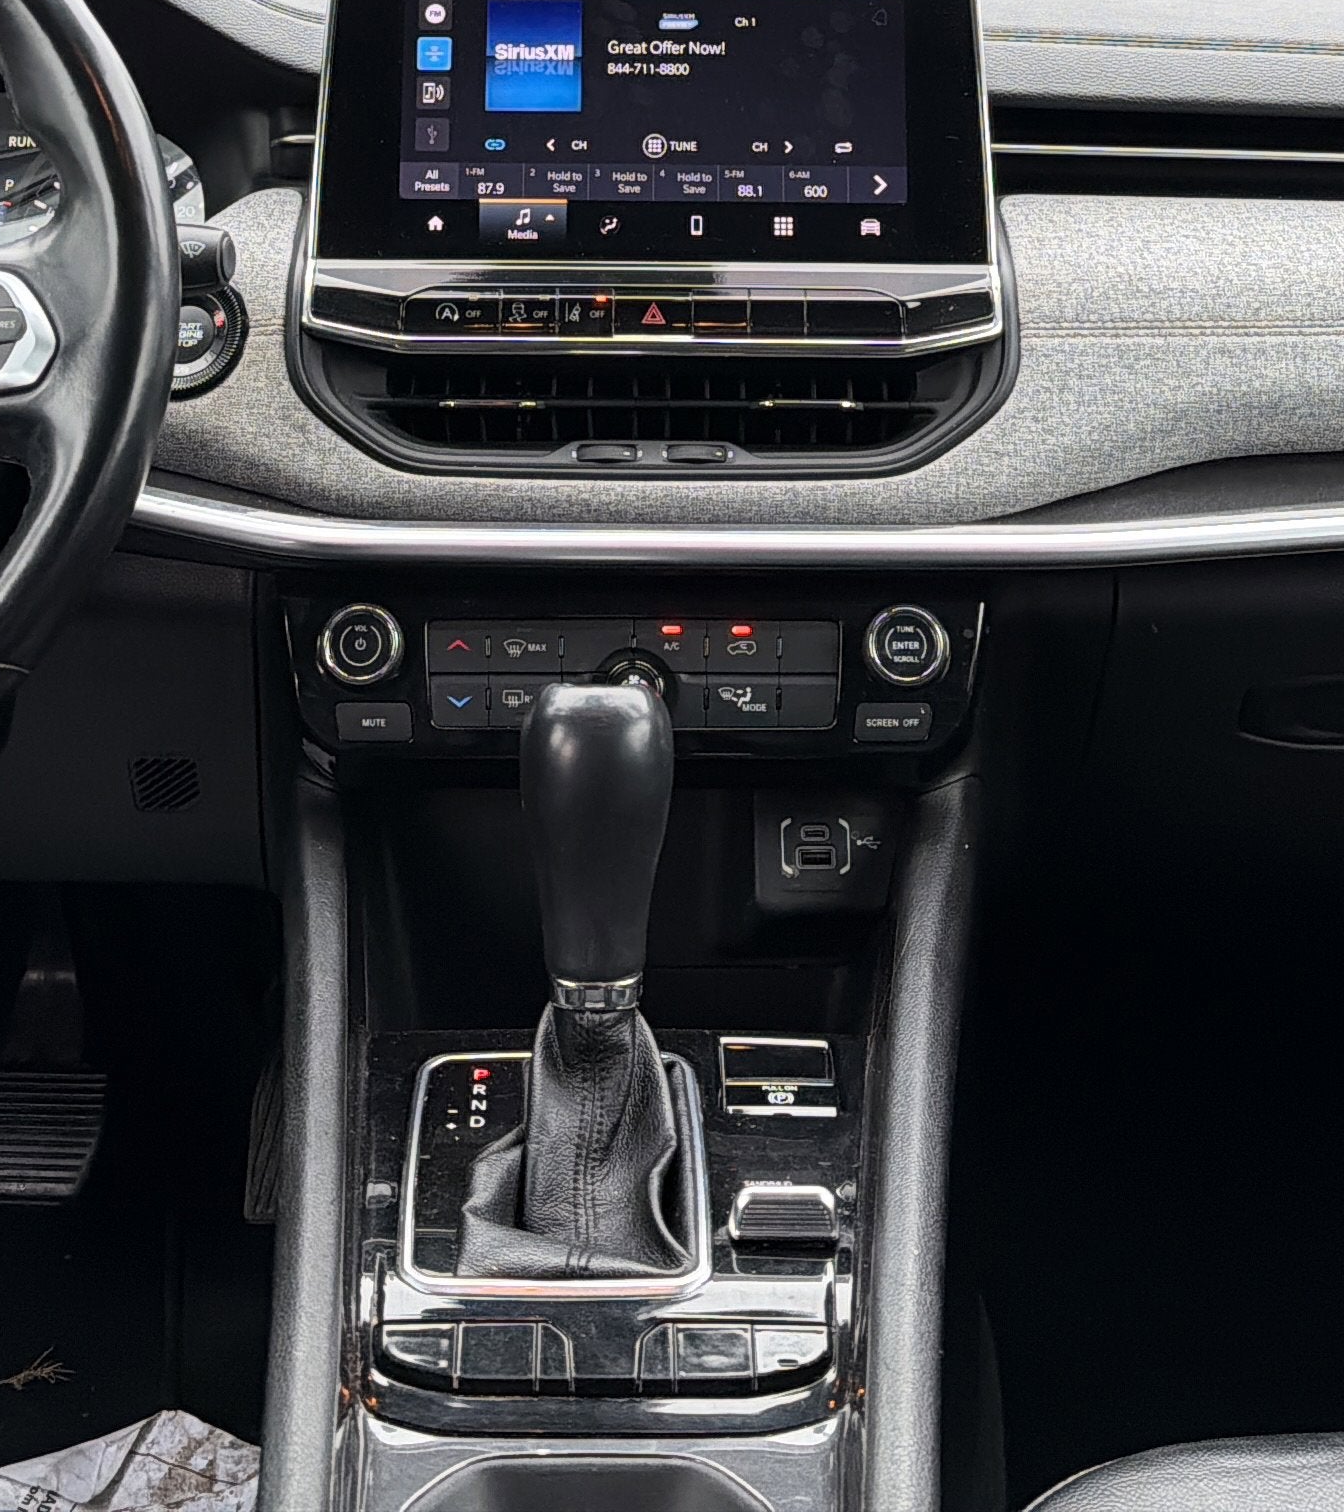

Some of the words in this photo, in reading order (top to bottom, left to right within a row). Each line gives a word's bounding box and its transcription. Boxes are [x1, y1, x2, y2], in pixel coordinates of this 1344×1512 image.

[428, 10, 443, 19] FM
[734, 17, 749, 28] Ch
[751, 17, 757, 27] 1
[494, 43, 575, 63] SiriusXM
[607, 41, 647, 55] Great
[649, 41, 686, 55] Offer
[688, 41, 726, 55] Now!
[607, 62, 690, 76] 844-711-8800
[571, 140, 588, 151] CH
[669, 140, 698, 152] TUNE
[752, 142, 768, 153] CH
[425, 169, 439, 180] All
[465, 167, 485, 177] 1-FM
[529, 168, 536, 177] 2
[547, 171, 570, 182] Hold
[571, 171, 583, 182] to
[594, 169, 601, 178] 3
[612, 172, 635, 182] Hold
[636, 172, 648, 182] to
[659, 169, 666, 178] 4
[677, 172, 700, 183] Hold
[701, 172, 713, 183] to
[724, 169, 745, 179] 5-FM
[788, 170, 811, 180] 6-AM
[4, 178, 14, 191] P
[414, 181, 451, 193] Presets
[477, 182, 505, 195] 87.9
[553, 182, 577, 194] Save
[617, 183, 641, 195] Save
[682, 184, 706, 195] Save
[737, 185, 763, 198] 88.1
[804, 185, 828, 198] 600
[178, 206, 197, 218] 20
[507, 228, 539, 240] Media
[464, 309, 482, 319] OFF
[532, 309, 549, 320] OFF
[589, 309, 606, 320] OFF
[177, 339, 198, 348] TOP
[354, 625, 369, 633] VOL
[896, 626, 915, 634] TUNE
[527, 643, 547, 653] MAX
[664, 641, 680, 651] A/C
[892, 641, 920, 651] ENTER
[892, 655, 920, 664] SCROLL
[742, 703, 768, 713] MODE
[361, 718, 387, 728] MUTE
[866, 718, 899, 727] SCREEN
[902, 718, 921, 727] OFF
[474, 1068, 490, 1081] P
[472, 1083, 487, 1095] R
[471, 1099, 487, 1111] N
[469, 1115, 486, 1128] D
